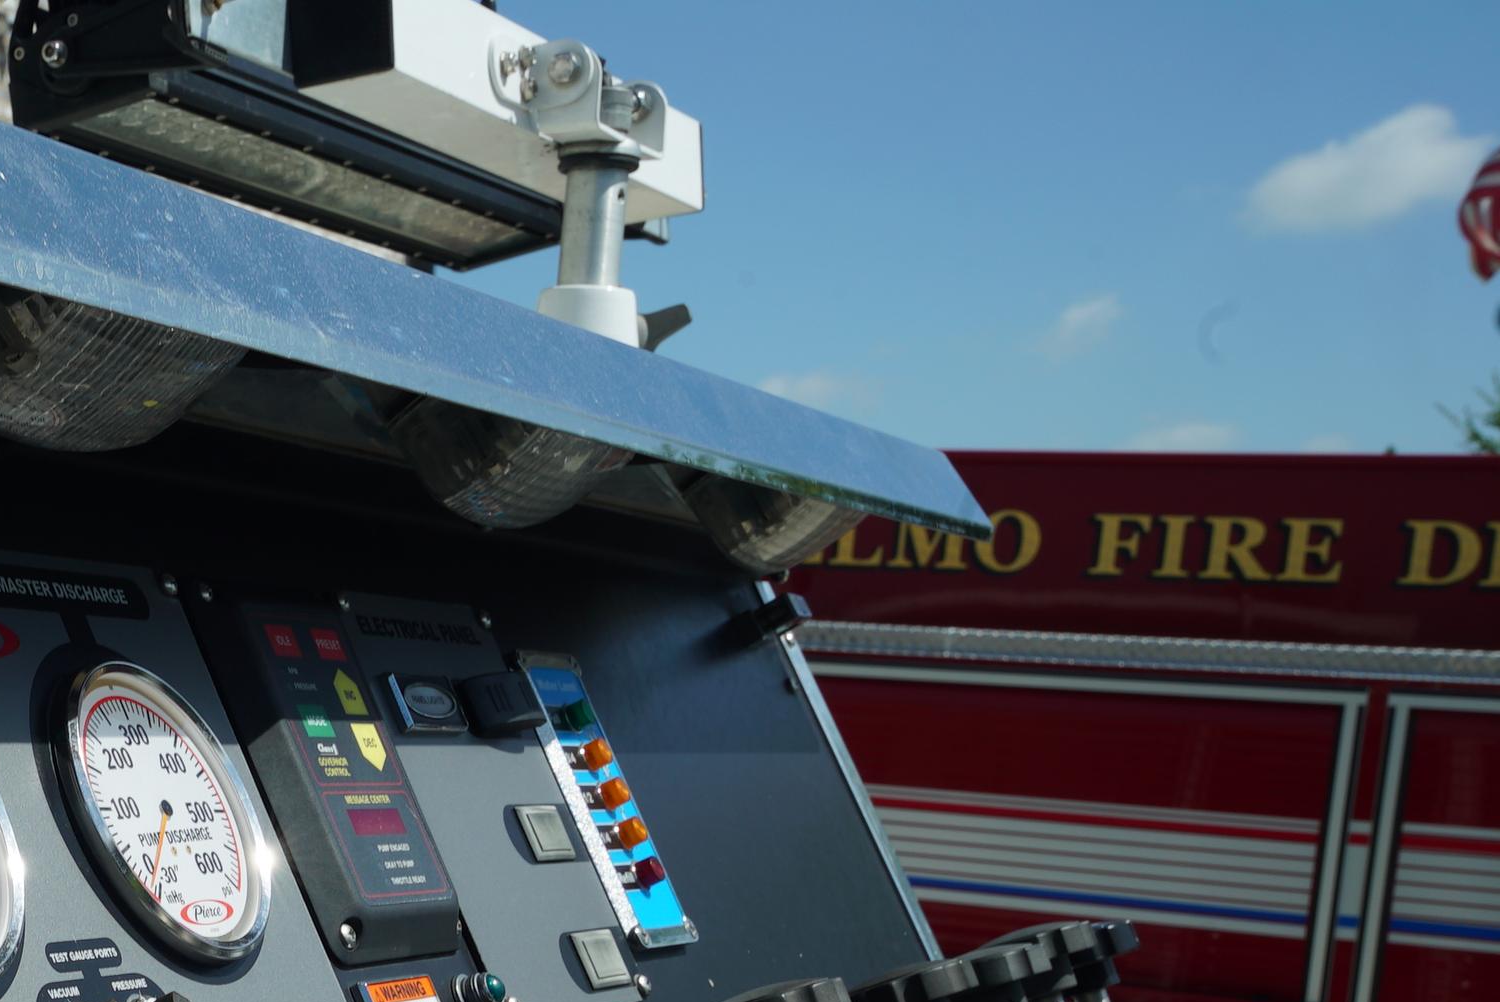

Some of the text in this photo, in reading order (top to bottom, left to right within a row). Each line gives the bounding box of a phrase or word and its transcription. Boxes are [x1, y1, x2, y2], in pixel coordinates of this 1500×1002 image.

[803, 508, 1042, 573] LMO
[1088, 513, 1344, 583] FIRE
[53, 581, 129, 605] DISCHARGE
[356, 615, 481, 645] ELECTRICAL PANEL
[118, 723, 149, 746] 300
[102, 748, 133, 770] 200
[159, 752, 187, 774] 400
[318, 757, 349, 767] GOVERNOR
[324, 767, 351, 777] CONTROL
[111, 796, 140, 820] 100
[344, 794, 391, 804] MESSAGE CENTER
[185, 801, 214, 824] 500
[164, 826, 213, 844] DISCHARGE
[142, 853, 155, 876] 0
[194, 851, 224, 875] 600
[165, 891, 186, 904] inHg
[221, 883, 233, 897] psi
[193, 903, 223, 921] Pierce
[50, 947, 118, 964] TEST GAUGE PORTS
[47, 985, 80, 1000] VACUUM
[111, 978, 148, 992] PRESSURE
[380, 981, 427, 1001] WARNING
